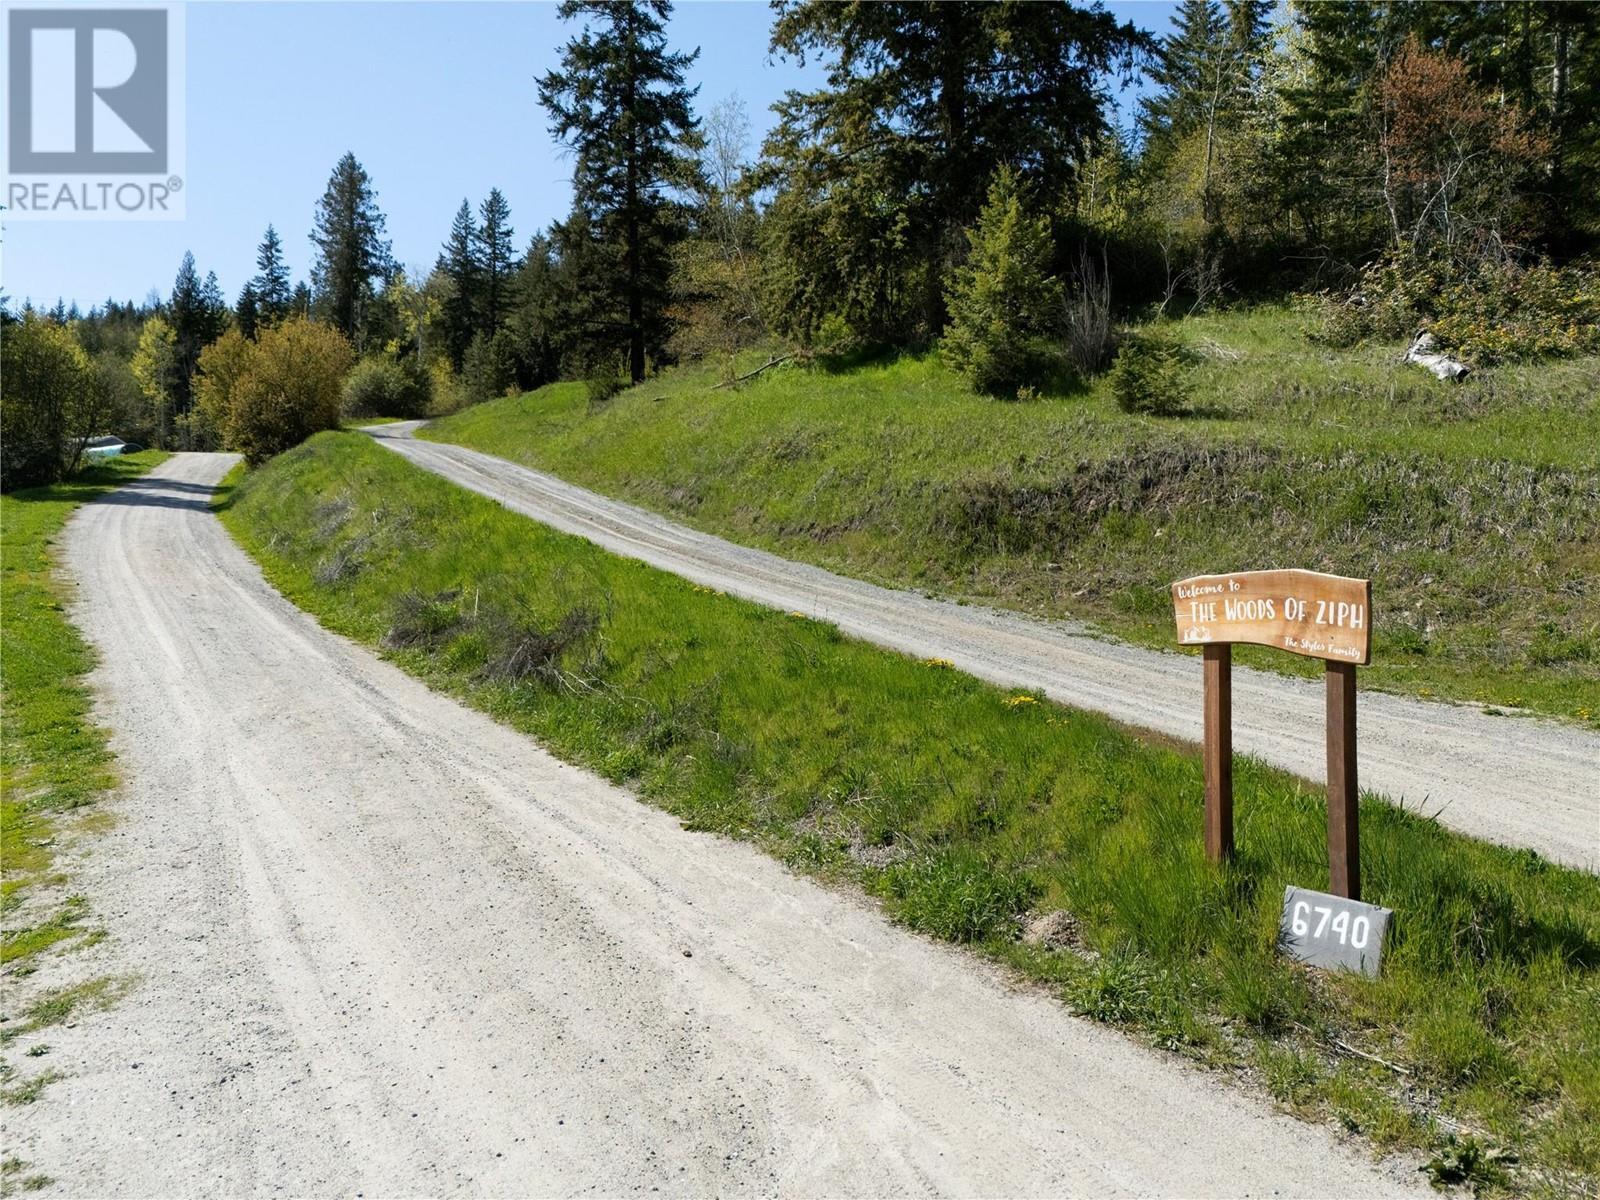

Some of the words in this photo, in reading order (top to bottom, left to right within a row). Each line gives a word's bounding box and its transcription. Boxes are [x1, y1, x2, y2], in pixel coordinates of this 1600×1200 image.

[1178, 582, 1224, 599] Welcome
[1229, 579, 1241, 592] to
[1189, 601, 1217, 624] THE
[1224, 598, 1276, 621] WOODS
[1284, 597, 1307, 622] OF
[1315, 600, 1364, 629] ZIPH
[1284, 637, 1298, 648] The
[1300, 638, 1325, 652] Styles
[1328, 642, 1361, 660] Family
[1292, 901, 1370, 949] 6740
